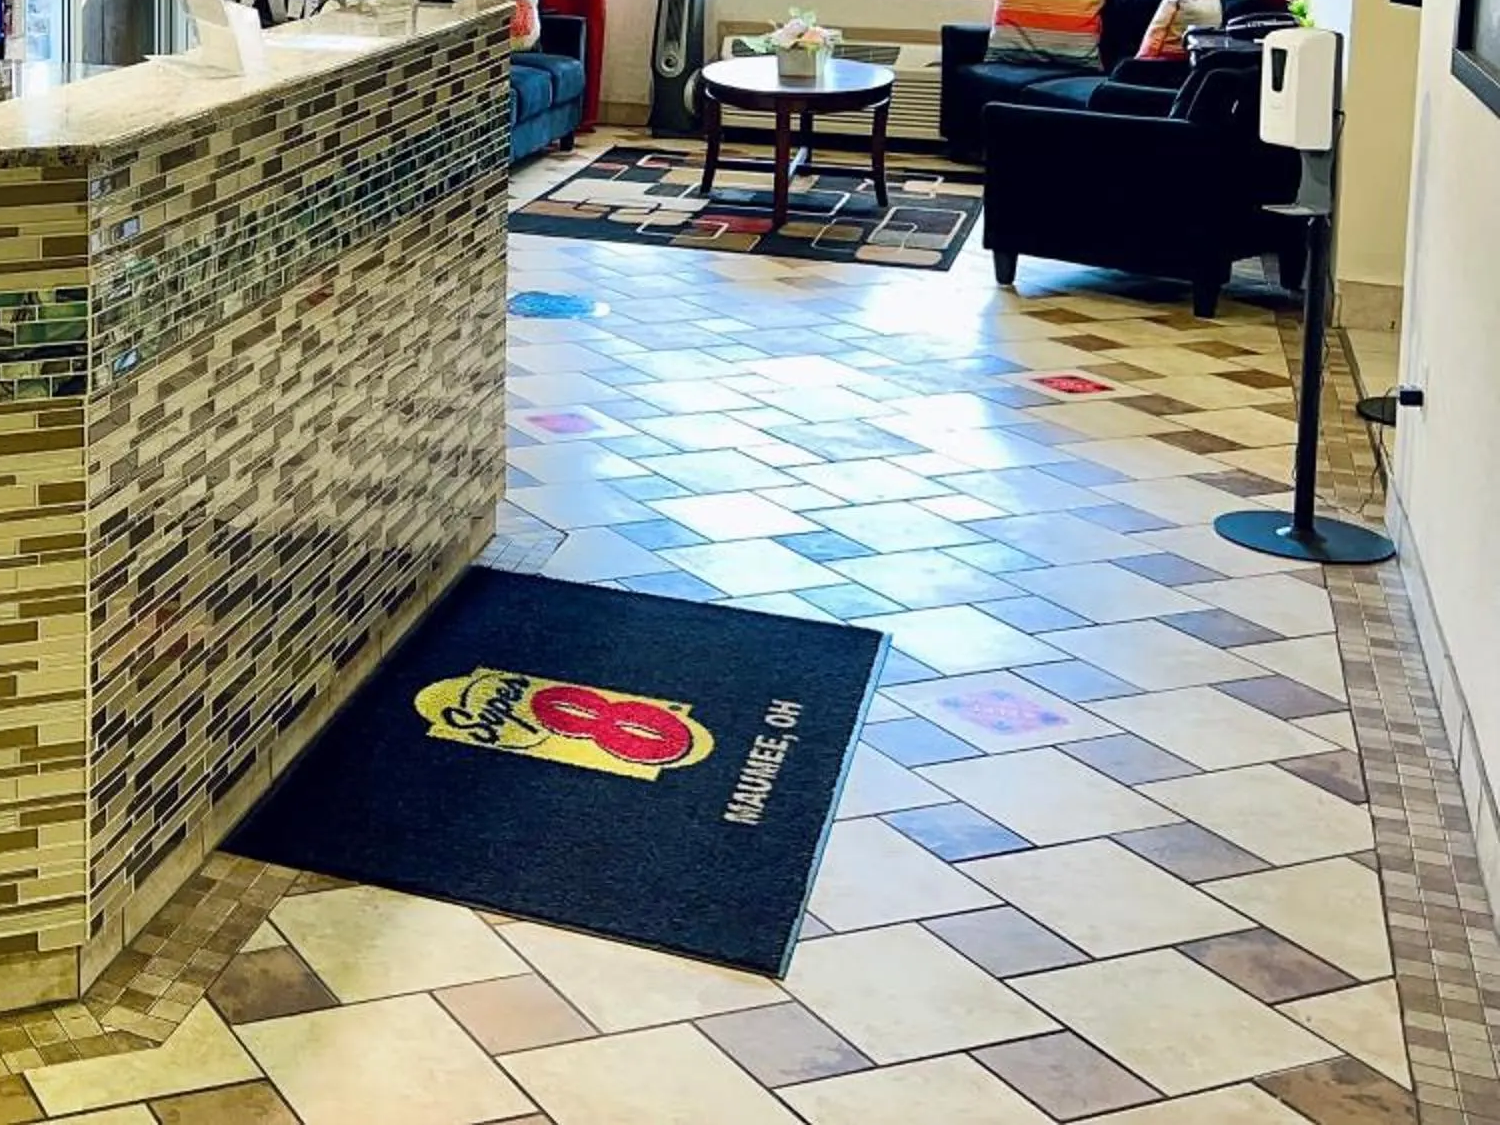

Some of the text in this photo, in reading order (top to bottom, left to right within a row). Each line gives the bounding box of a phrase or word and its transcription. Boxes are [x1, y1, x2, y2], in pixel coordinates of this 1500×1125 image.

[440, 674, 537, 744] Super
[528, 684, 695, 765] 8
[722, 699, 801, 826] MAUMEE, OH
